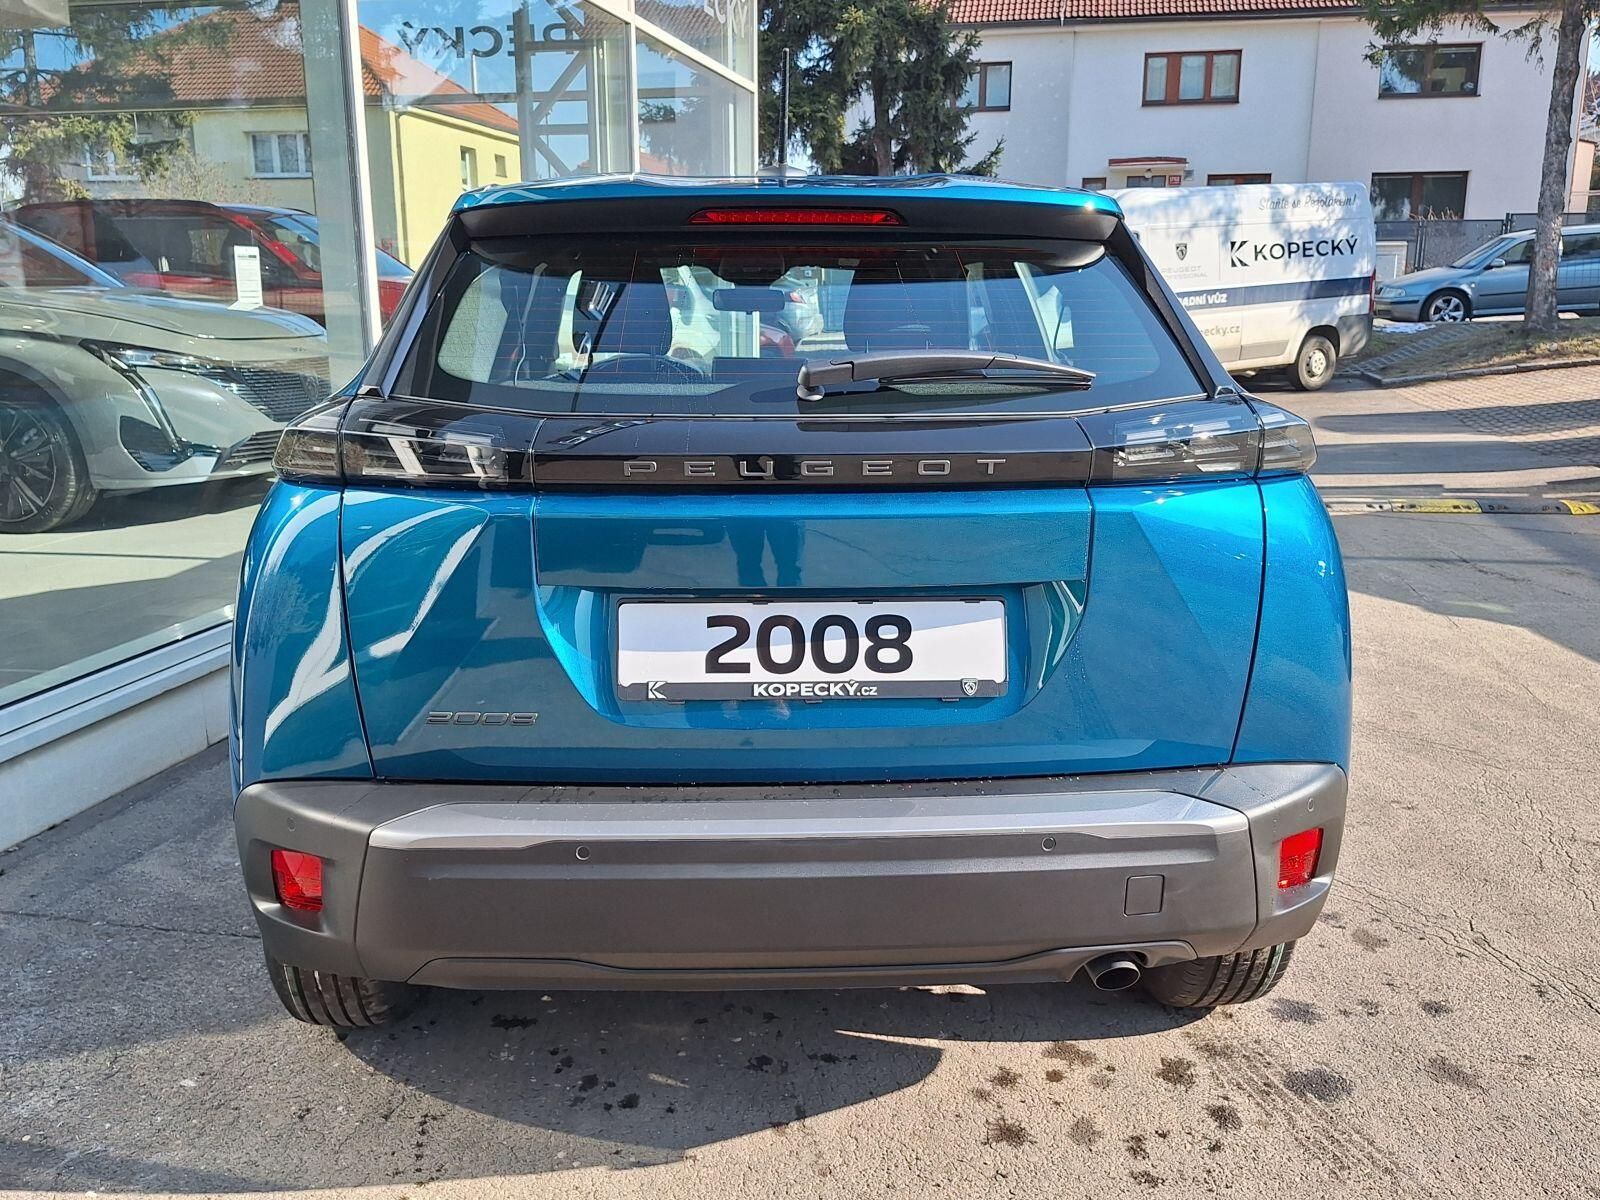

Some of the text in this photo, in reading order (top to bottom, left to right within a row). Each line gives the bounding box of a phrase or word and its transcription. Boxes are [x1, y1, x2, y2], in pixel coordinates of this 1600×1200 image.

[1254, 234, 1358, 261] KOPECKÝ
[1207, 291, 1227, 304] VŮZ
[1200, 325, 1240, 337] ecky.cz
[623, 458, 1006, 477] PEUGEOT
[705, 614, 914, 675] 2008
[426, 711, 538, 726] 2008
